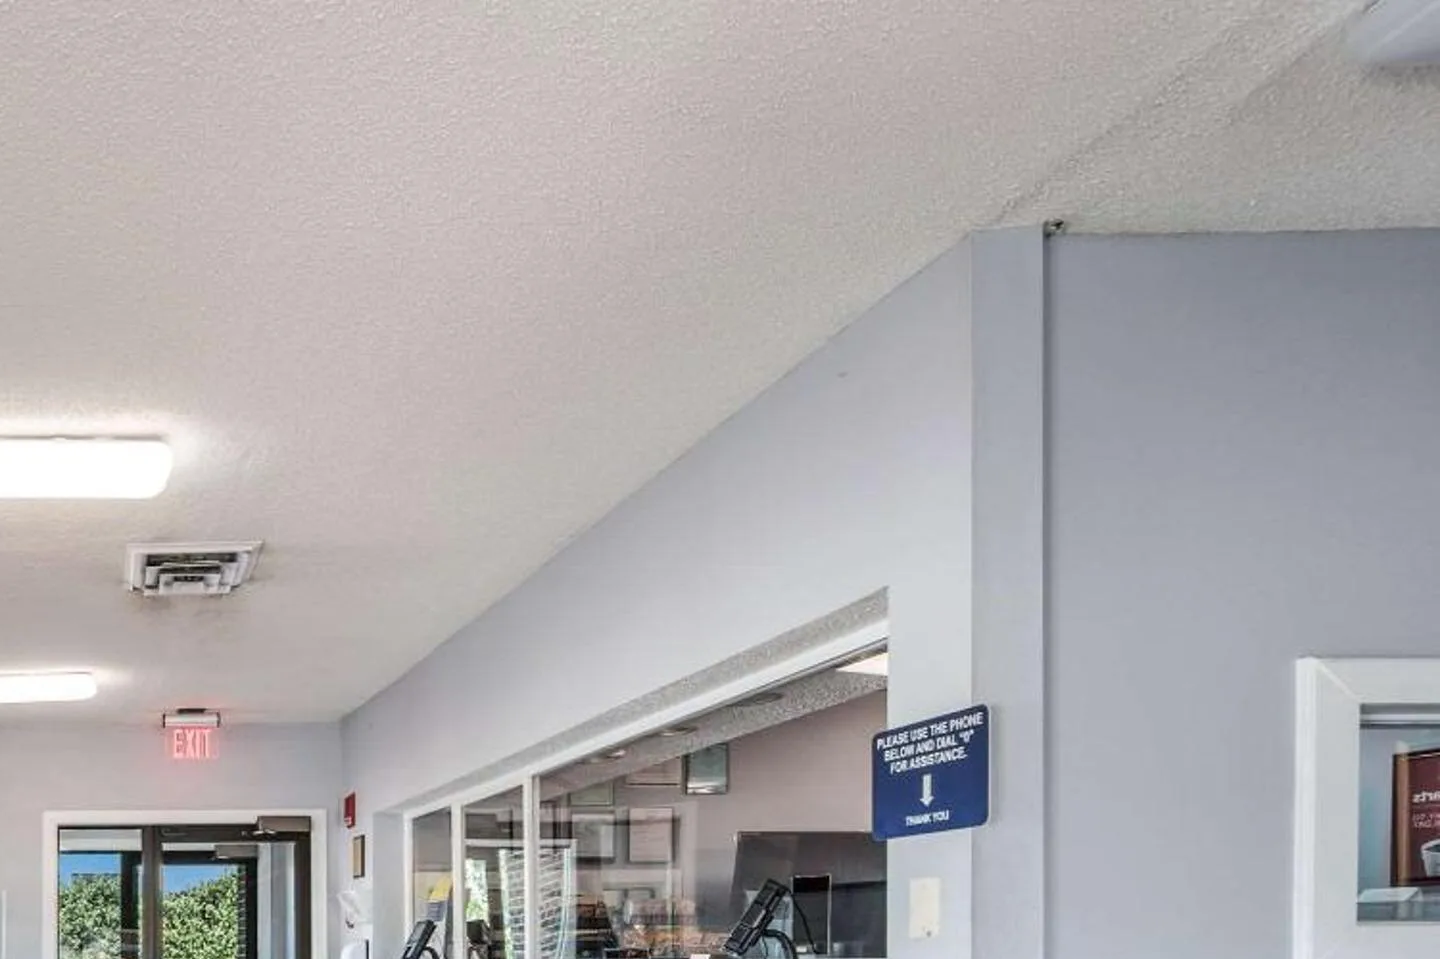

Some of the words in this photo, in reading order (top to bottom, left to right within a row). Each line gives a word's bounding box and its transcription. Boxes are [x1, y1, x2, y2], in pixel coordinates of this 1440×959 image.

[173, 728, 212, 759] EXIT
[877, 733, 909, 750] PLEASE
[910, 727, 929, 742] USE
[930, 722, 949, 736] THE
[950, 712, 984, 732] PHONE
[884, 744, 915, 762] BELOW
[915, 740, 935, 755] AND
[936, 735, 957, 751] DIAL
[890, 761, 907, 775] FOR
[905, 813, 932, 827] THANK
[933, 810, 950, 822] YOU
